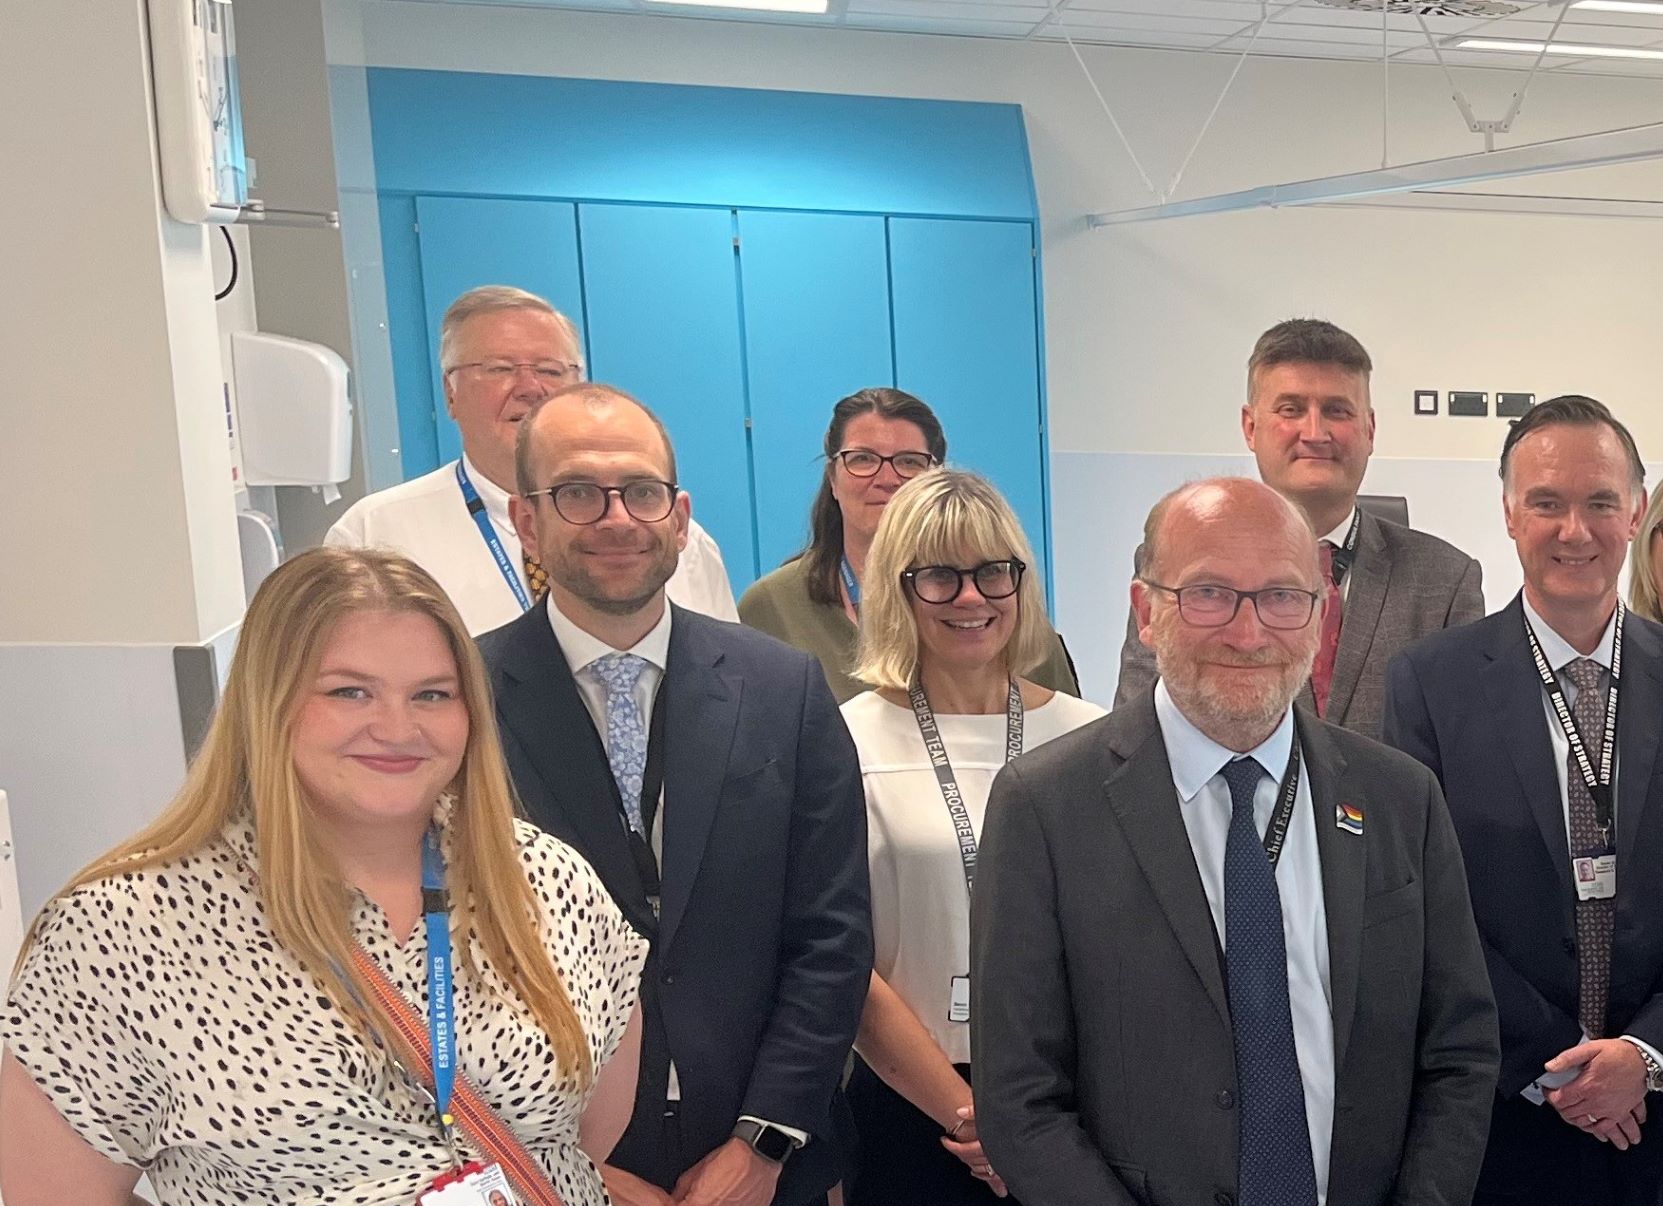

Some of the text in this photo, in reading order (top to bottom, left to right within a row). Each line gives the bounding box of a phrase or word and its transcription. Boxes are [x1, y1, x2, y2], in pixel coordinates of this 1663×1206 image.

[1532, 645, 1555, 684] STRATEGY
[909, 688, 948, 767] UREMENT TEAM
[1551, 691, 1598, 787] DIRECTOR OF STRATEGY
[1600, 687, 1618, 786] DIRECTOR OF STRATEGY
[941, 782, 978, 867] PROCUREMENT
[1267, 774, 1298, 863] Chief Executive
[434, 956, 449, 1069] ESTATES & FACILITIES
